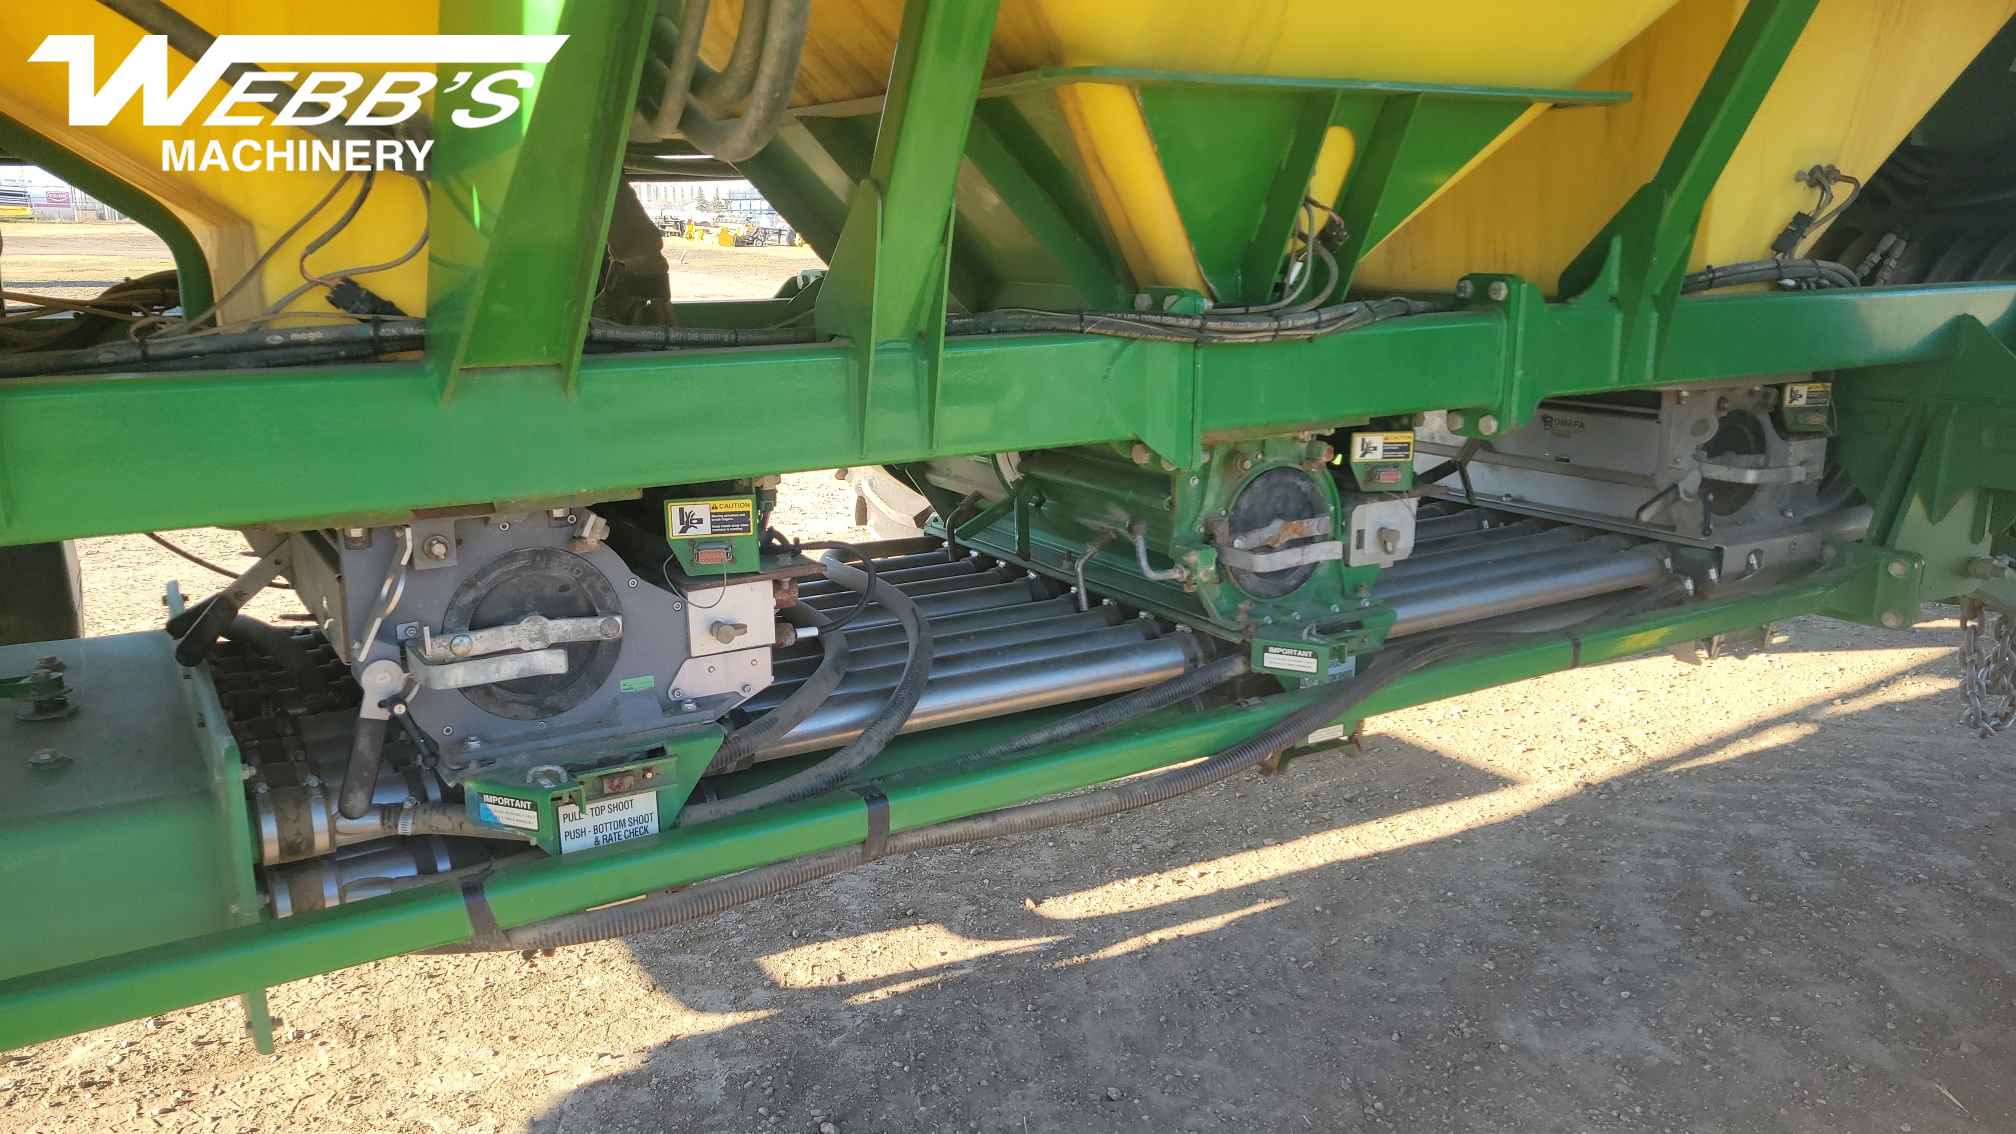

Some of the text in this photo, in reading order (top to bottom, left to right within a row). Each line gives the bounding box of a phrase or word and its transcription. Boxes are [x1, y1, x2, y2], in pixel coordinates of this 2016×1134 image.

[1268, 646, 1313, 658] IMPORTANT
[483, 794, 532, 810] IMPORTANT
[562, 810, 583, 824] PULL
[590, 805, 606, 817] TOP
[607, 799, 634, 813] SHOOT
[564, 827, 587, 842] PUSH
[593, 818, 627, 835] BOTTOM
[627, 812, 654, 826] SHOOT
[594, 825, 649, 846] & RATE CHECK
